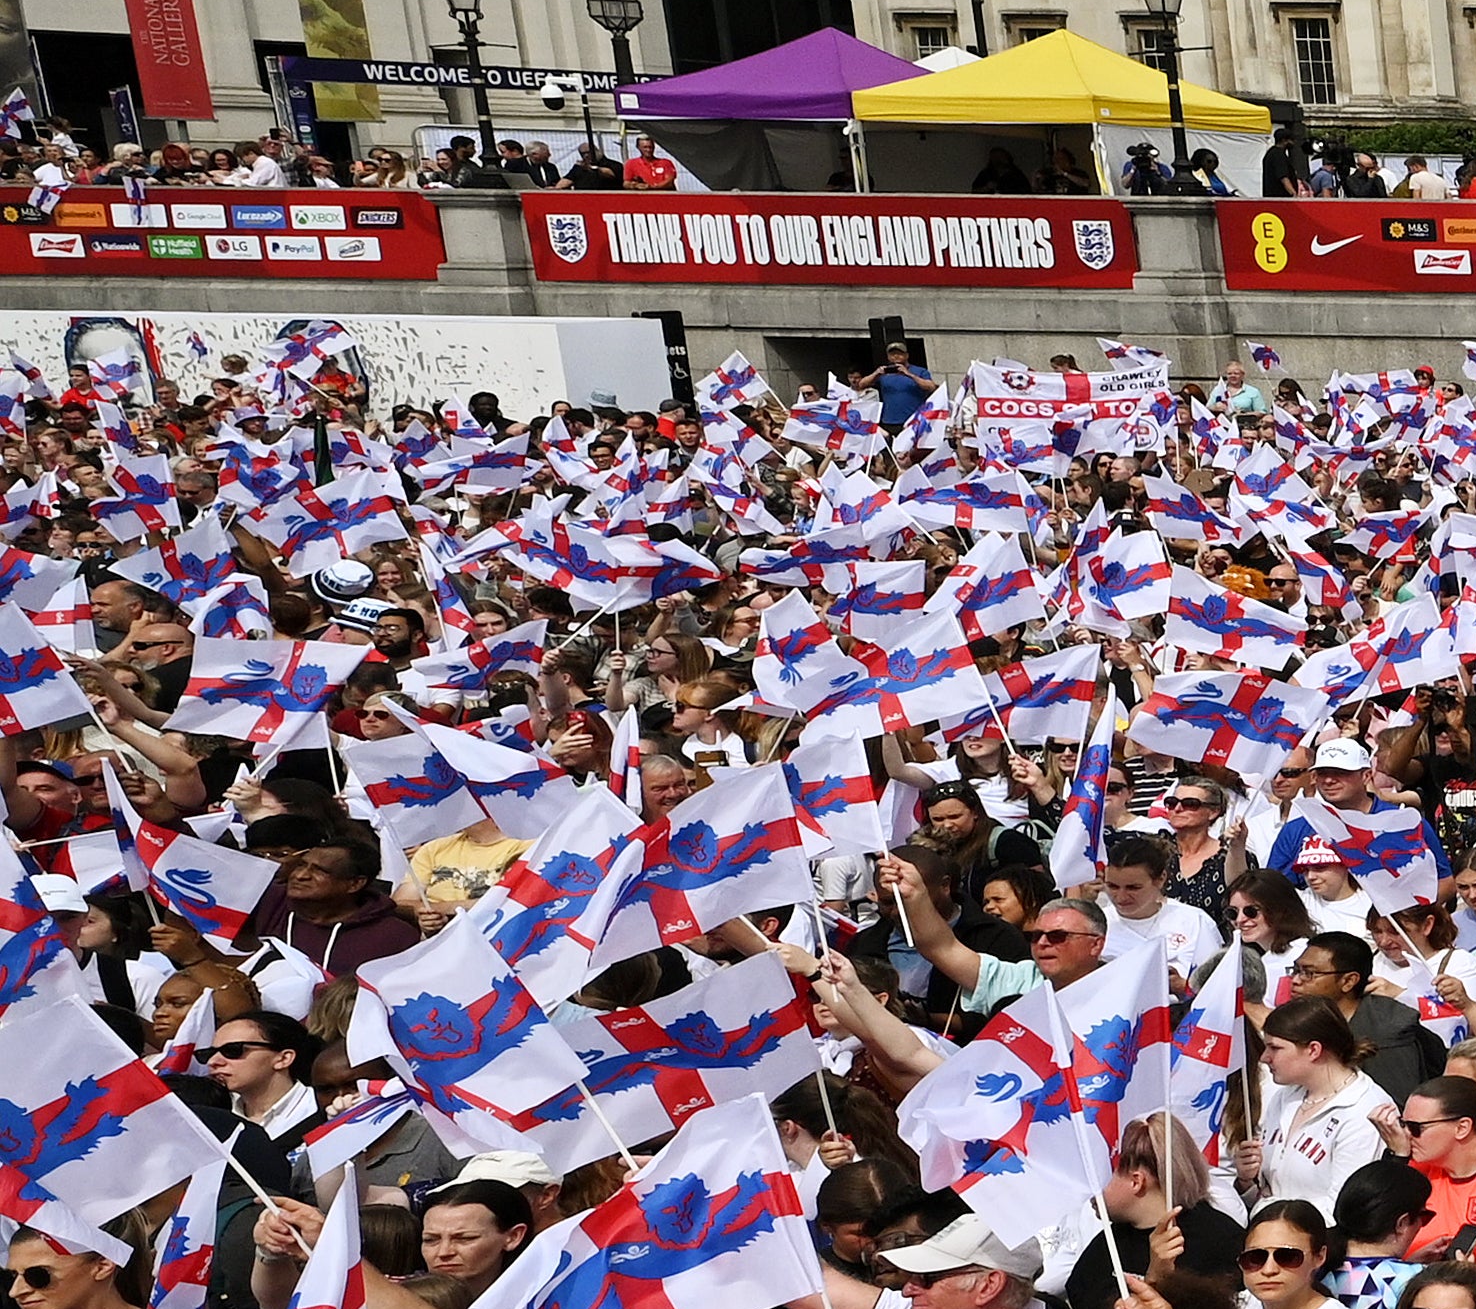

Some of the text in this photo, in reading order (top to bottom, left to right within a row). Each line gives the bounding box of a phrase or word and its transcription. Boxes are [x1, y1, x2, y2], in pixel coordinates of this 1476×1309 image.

[363, 63, 471, 85] WELCOME
[236, 210, 276, 222] Lucozade
[311, 214, 342, 223] XBOX
[359, 212, 397, 223] SNICKERS
[1407, 222, 1430, 234] M&S
[101, 241, 141, 251] Nationwide
[167, 239, 197, 249] Nuffield
[602, 212, 1055, 269] THANK YOU TO OUR ENGLAND PARTNERS
[168, 246, 194, 256] Health
[232, 241, 248, 252] LG
[284, 244, 315, 254] PayPal
[1099, 379, 1166, 392] OLD GIRLS
[983, 400, 1055, 417] COGS
[1104, 402, 1136, 416] TO
